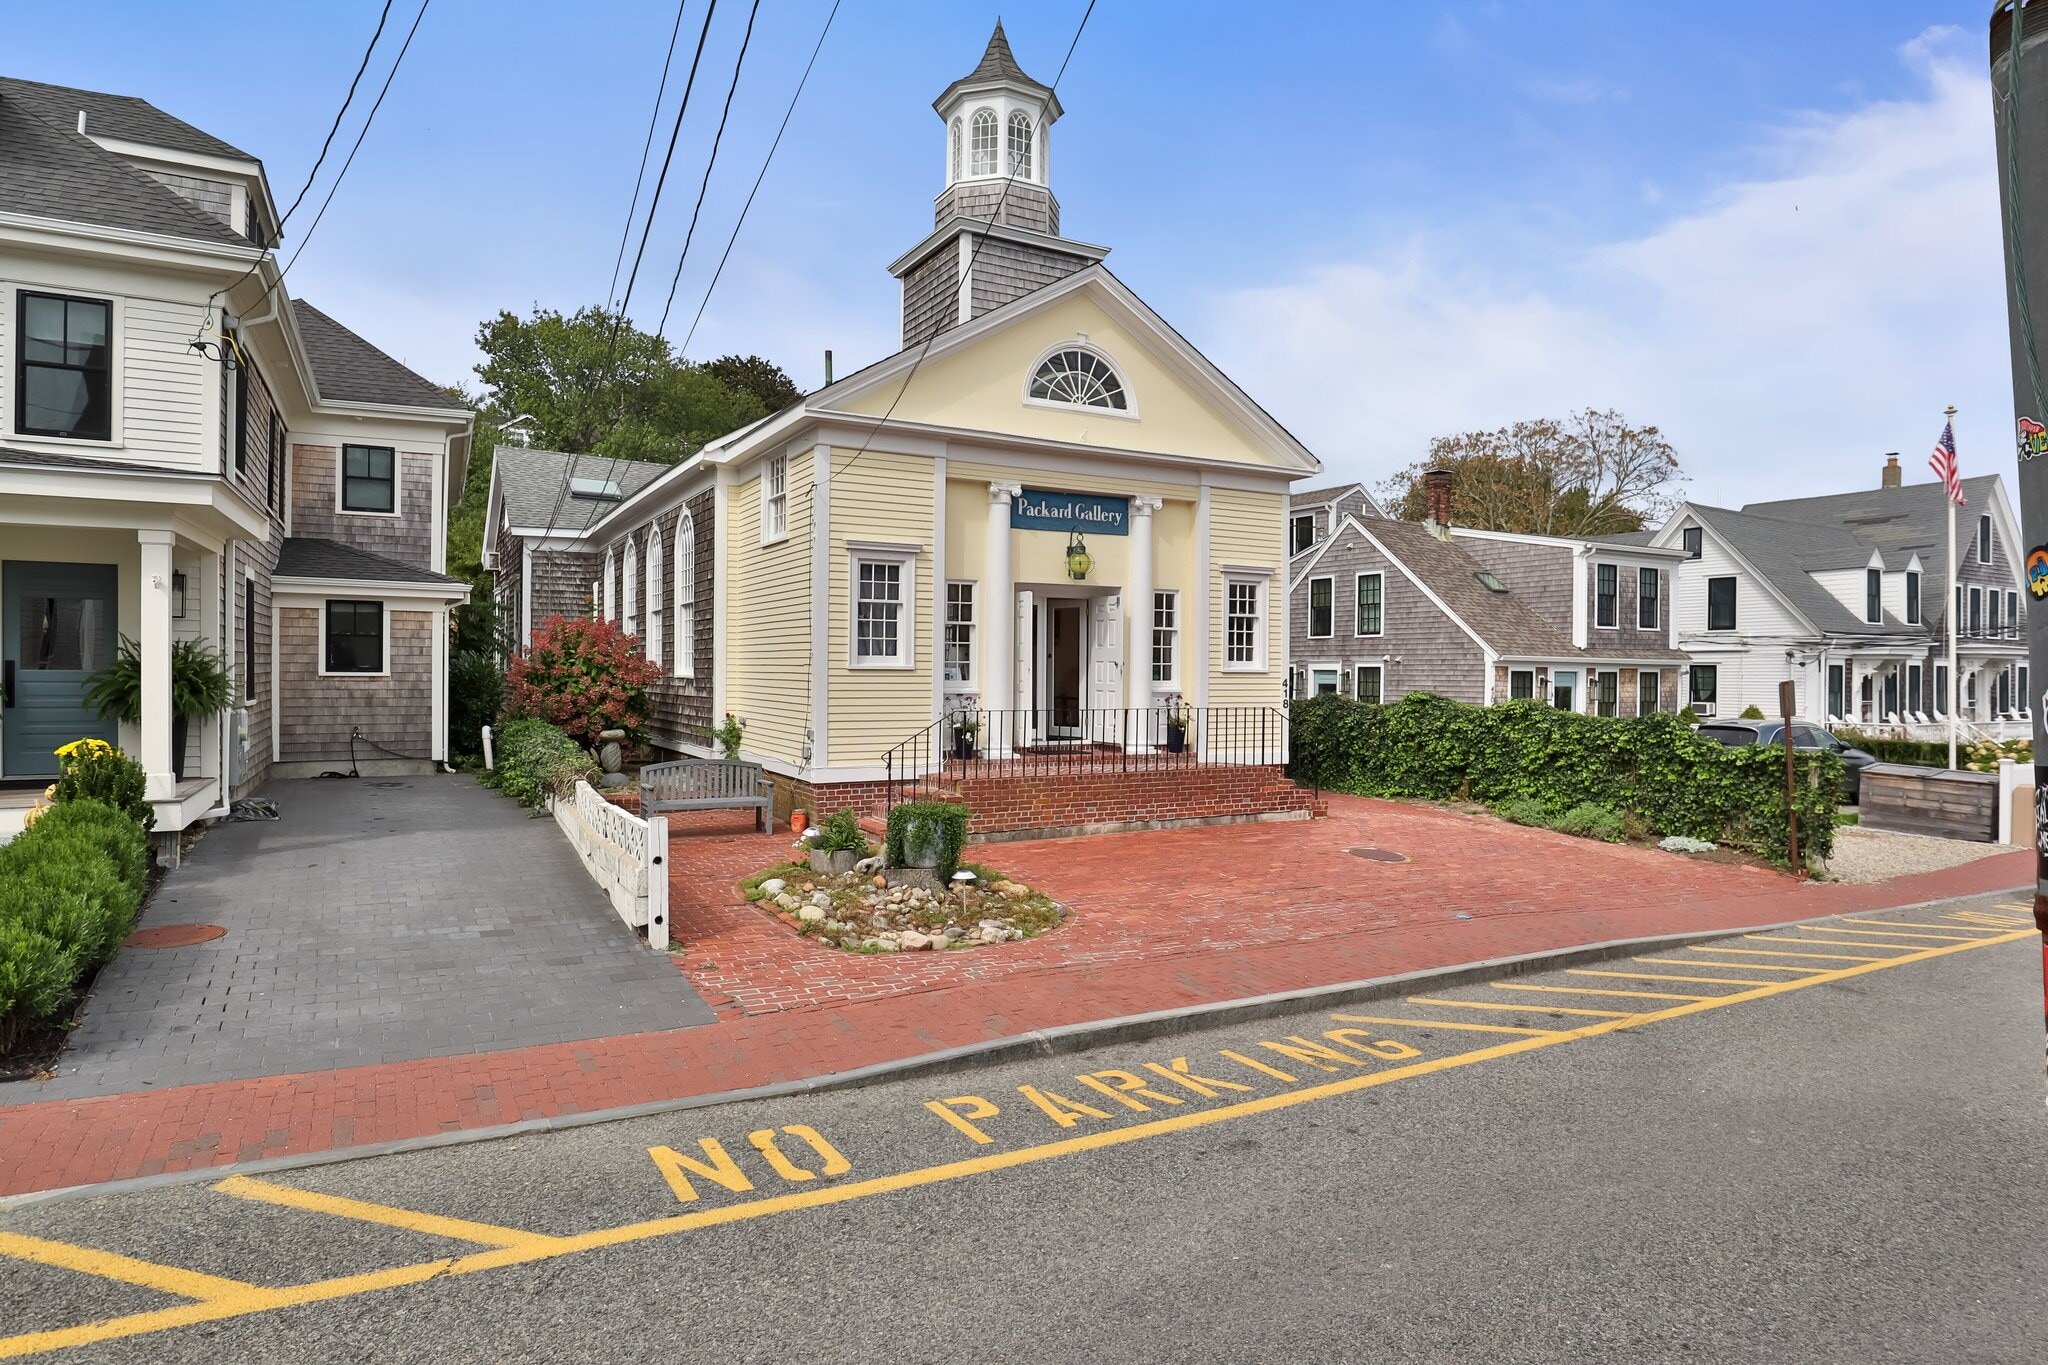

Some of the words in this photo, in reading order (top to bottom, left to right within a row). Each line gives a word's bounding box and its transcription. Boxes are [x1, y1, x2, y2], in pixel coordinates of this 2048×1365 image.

[1018, 498, 1072, 518] Packard
[1075, 503, 1122, 525] Gallery
[647, 1124, 852, 1203] NO
[924, 1028, 1422, 1144] PARKING
